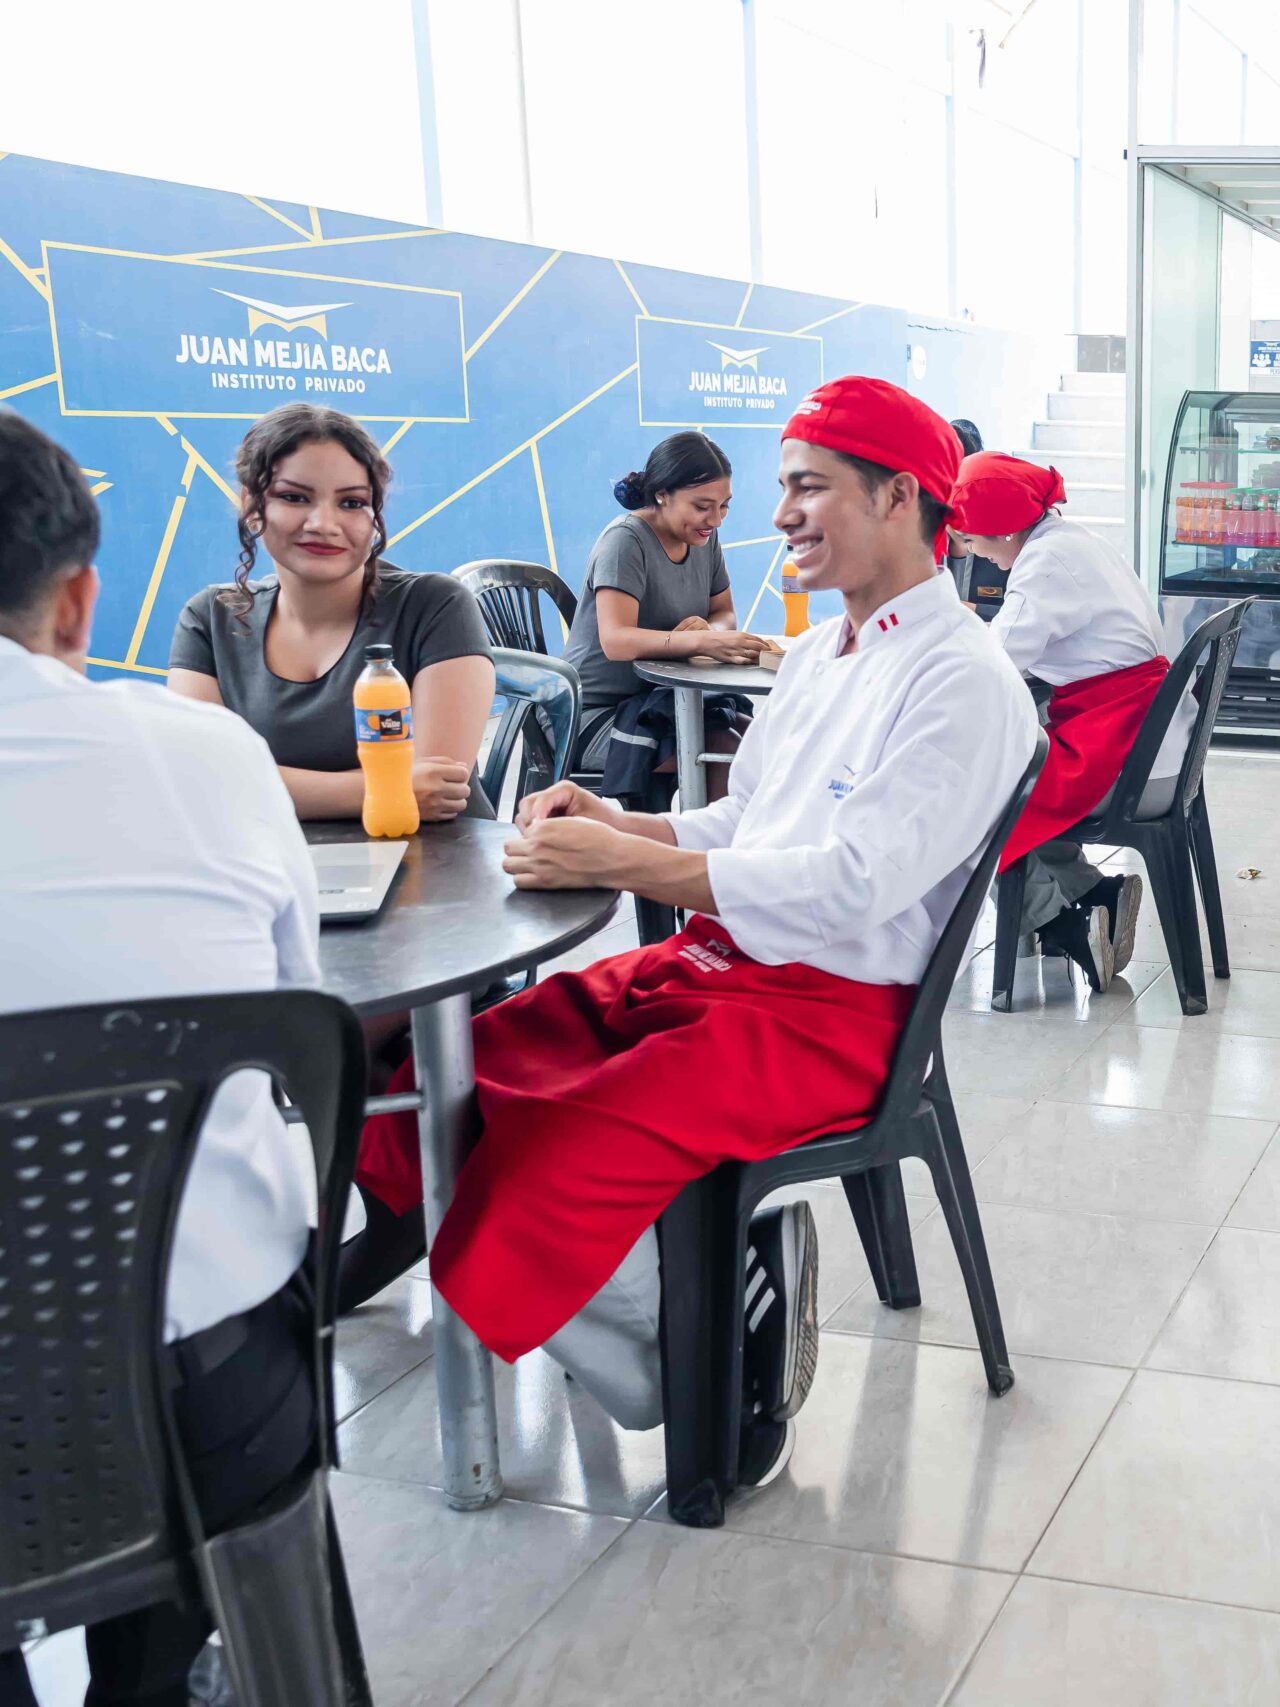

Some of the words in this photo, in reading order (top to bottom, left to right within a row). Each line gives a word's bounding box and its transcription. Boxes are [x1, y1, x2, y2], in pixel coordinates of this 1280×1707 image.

[176, 334, 248, 366] JUAN
[331, 345, 392, 374] BACA
[211, 373, 297, 391] INSTITUTO
[305, 377, 366, 393] PRIVADO
[688, 371, 721, 392] JUAN
[759, 377, 788, 396] BACA
[704, 396, 743, 408] INSTITUTO
[746, 398, 776, 409] PRIVADO
